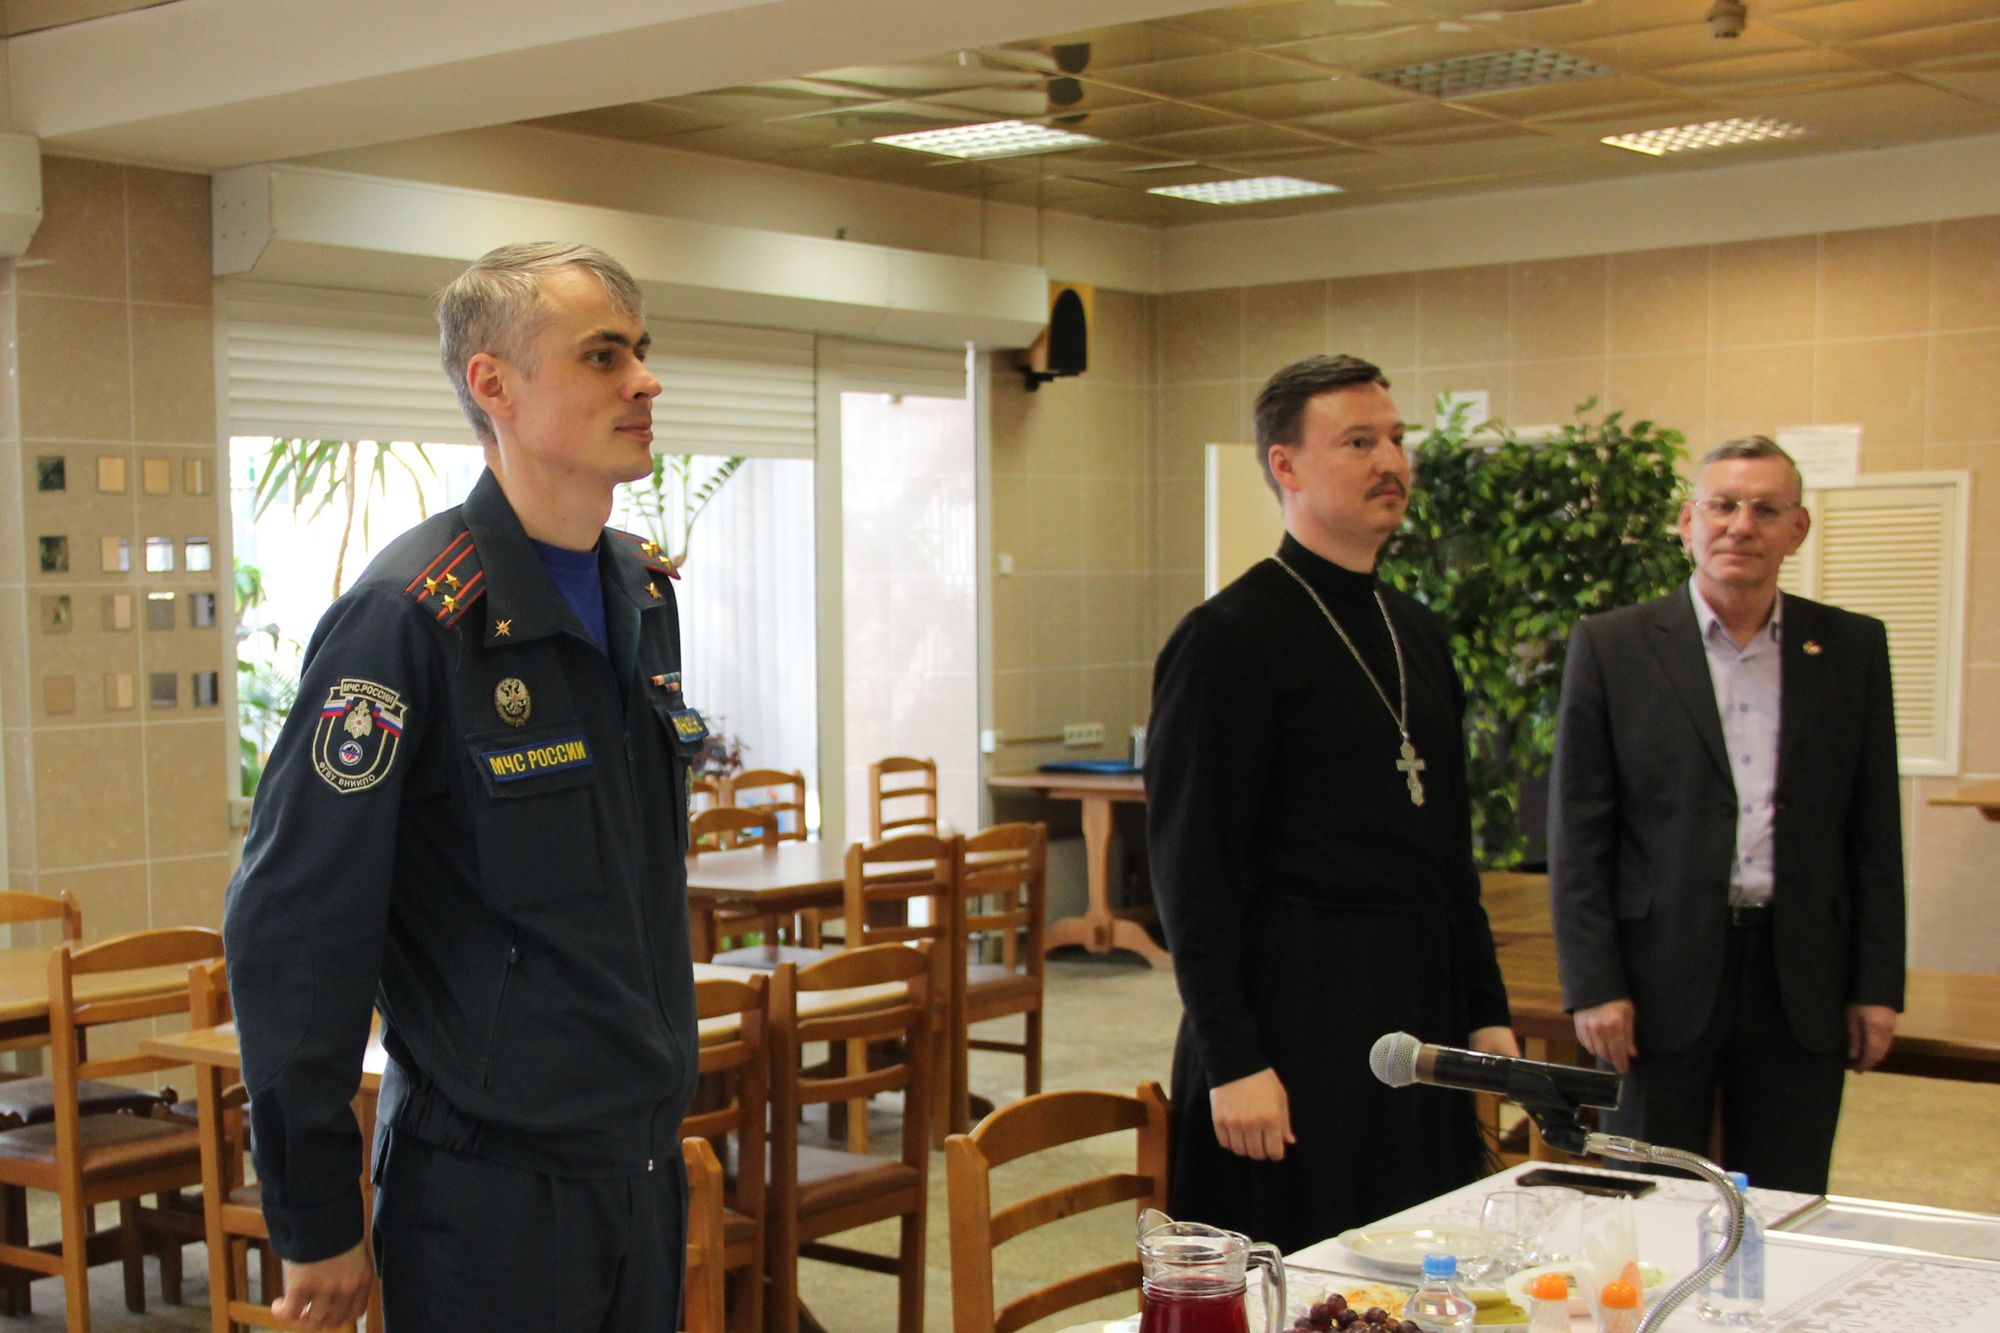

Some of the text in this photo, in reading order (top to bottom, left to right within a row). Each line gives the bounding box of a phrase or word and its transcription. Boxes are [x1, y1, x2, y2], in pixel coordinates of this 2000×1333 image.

[343, 683, 395, 704] МЧС РОССИИ
[489, 741, 586, 775] МЧС РОССИИ
